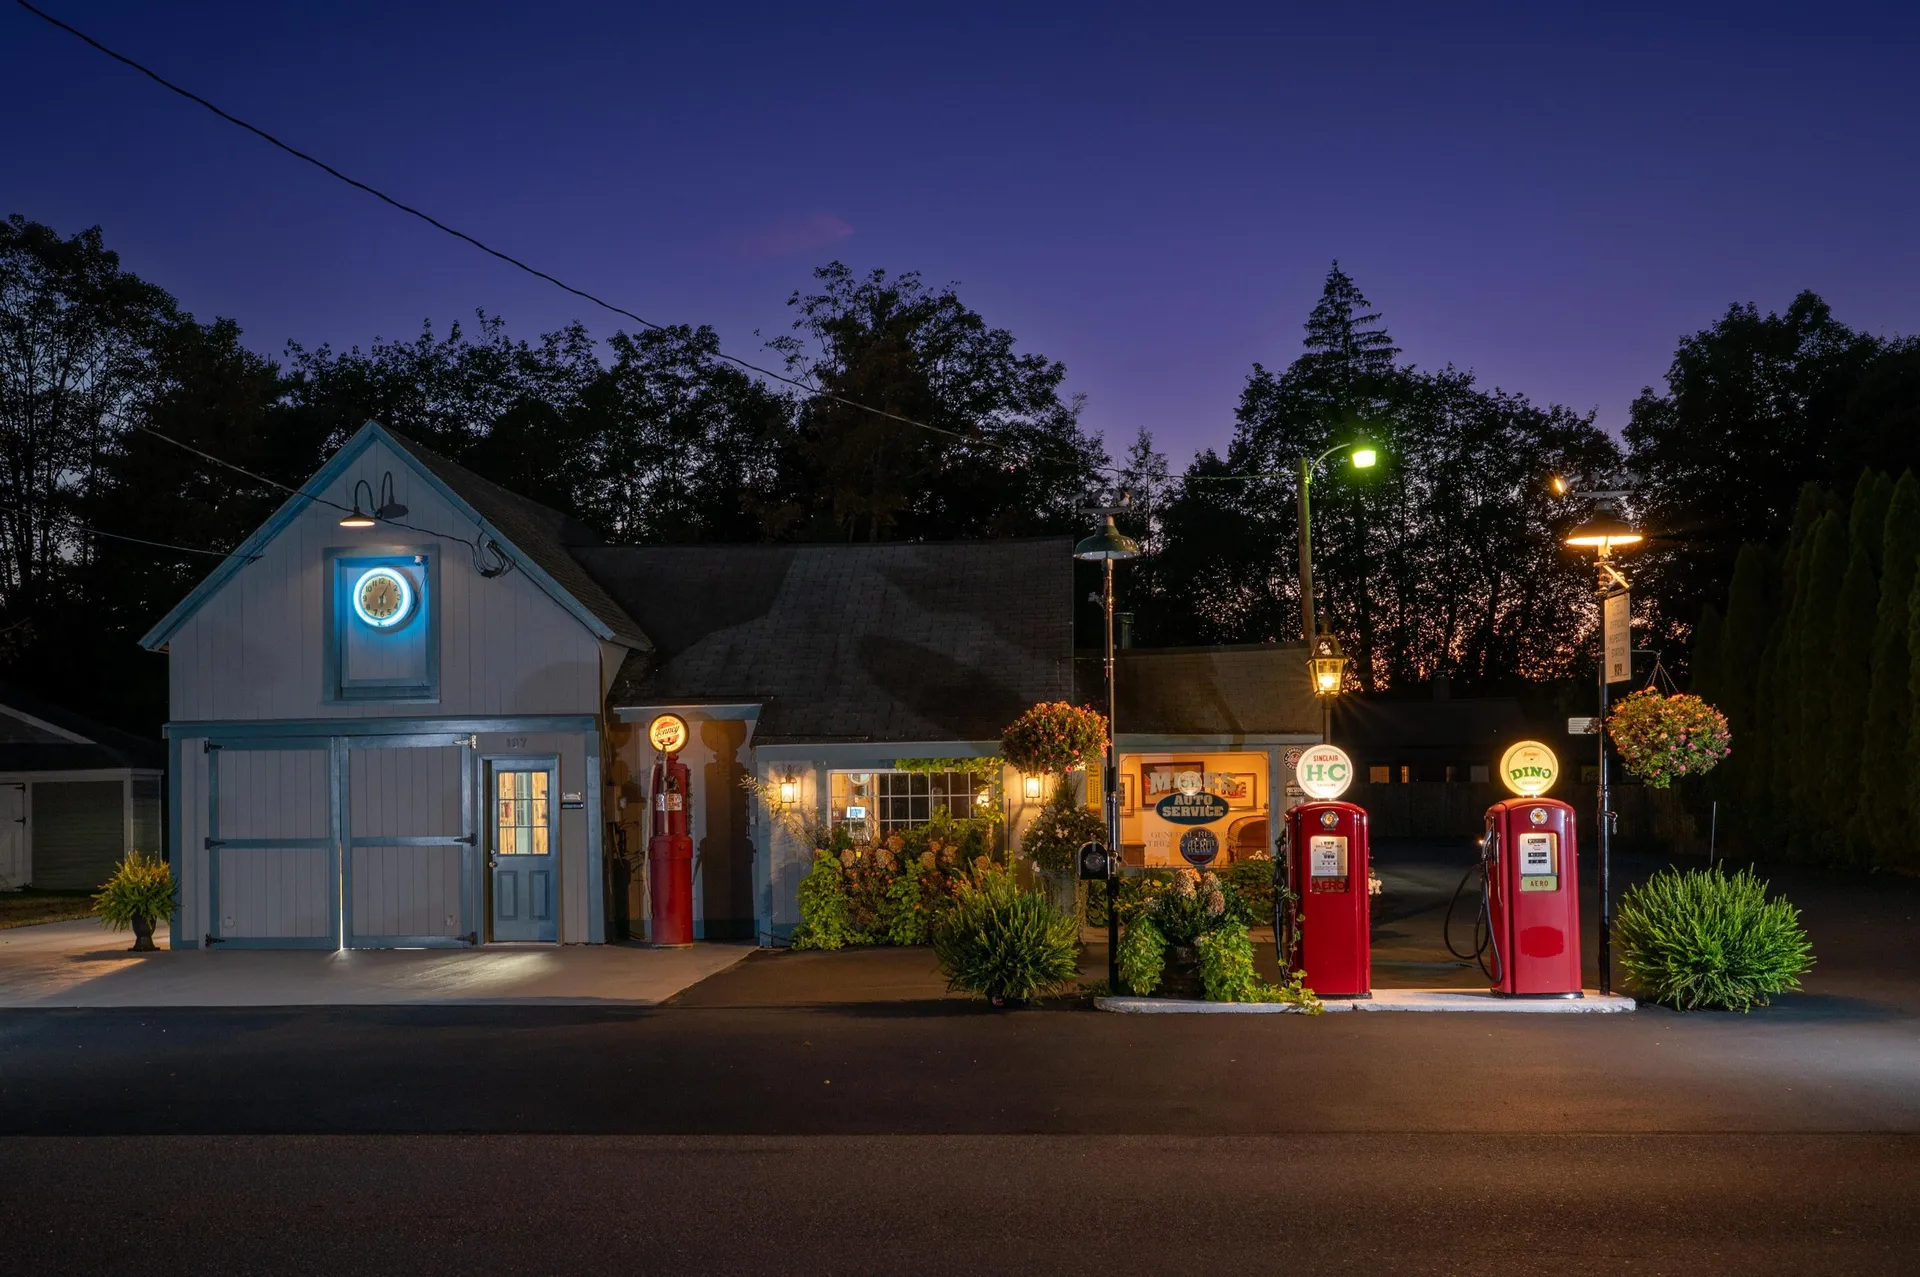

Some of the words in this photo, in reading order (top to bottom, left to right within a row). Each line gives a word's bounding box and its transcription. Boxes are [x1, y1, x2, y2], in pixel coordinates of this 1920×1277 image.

[1306, 763, 1347, 782] H-C
[1510, 766, 1552, 780] DINO
[1174, 795, 1213, 806] AUTO
[1162, 806, 1224, 817] SERVICE
[1312, 880, 1345, 890] AERO
